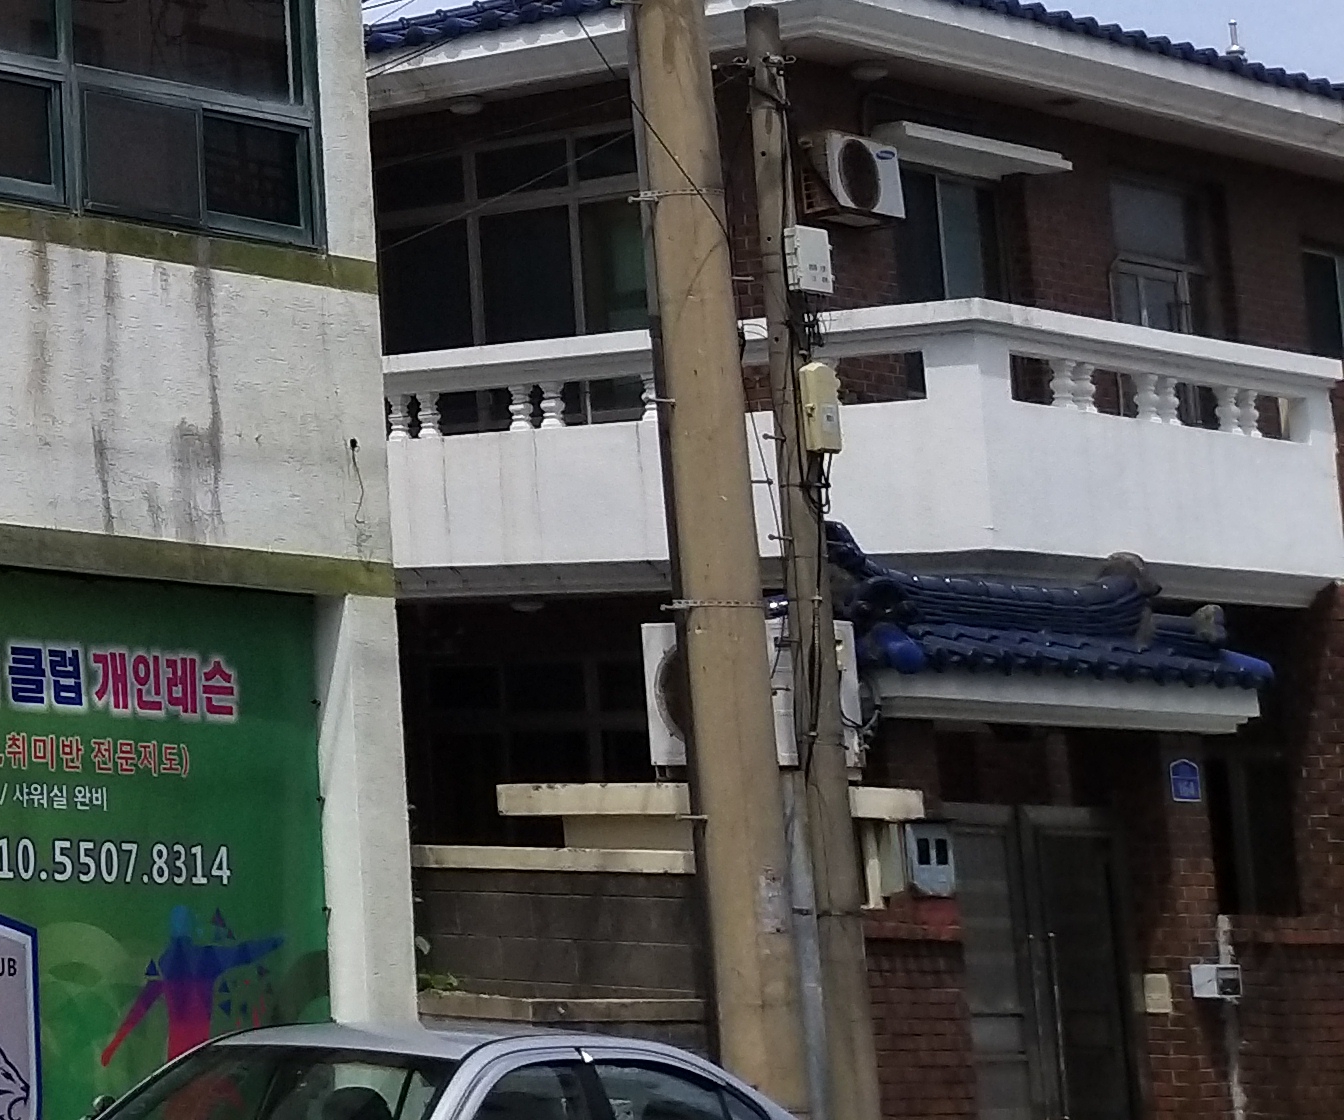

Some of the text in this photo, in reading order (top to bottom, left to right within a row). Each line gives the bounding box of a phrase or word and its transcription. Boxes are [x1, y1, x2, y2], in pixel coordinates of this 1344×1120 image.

[7, 644, 85, 709] 클럽
[90, 649, 237, 719] 개인레슨
[91, 737, 190, 777] 전문지도)
[13, 783, 68, 809] 샤워실
[74, 786, 108, 811] 완비
